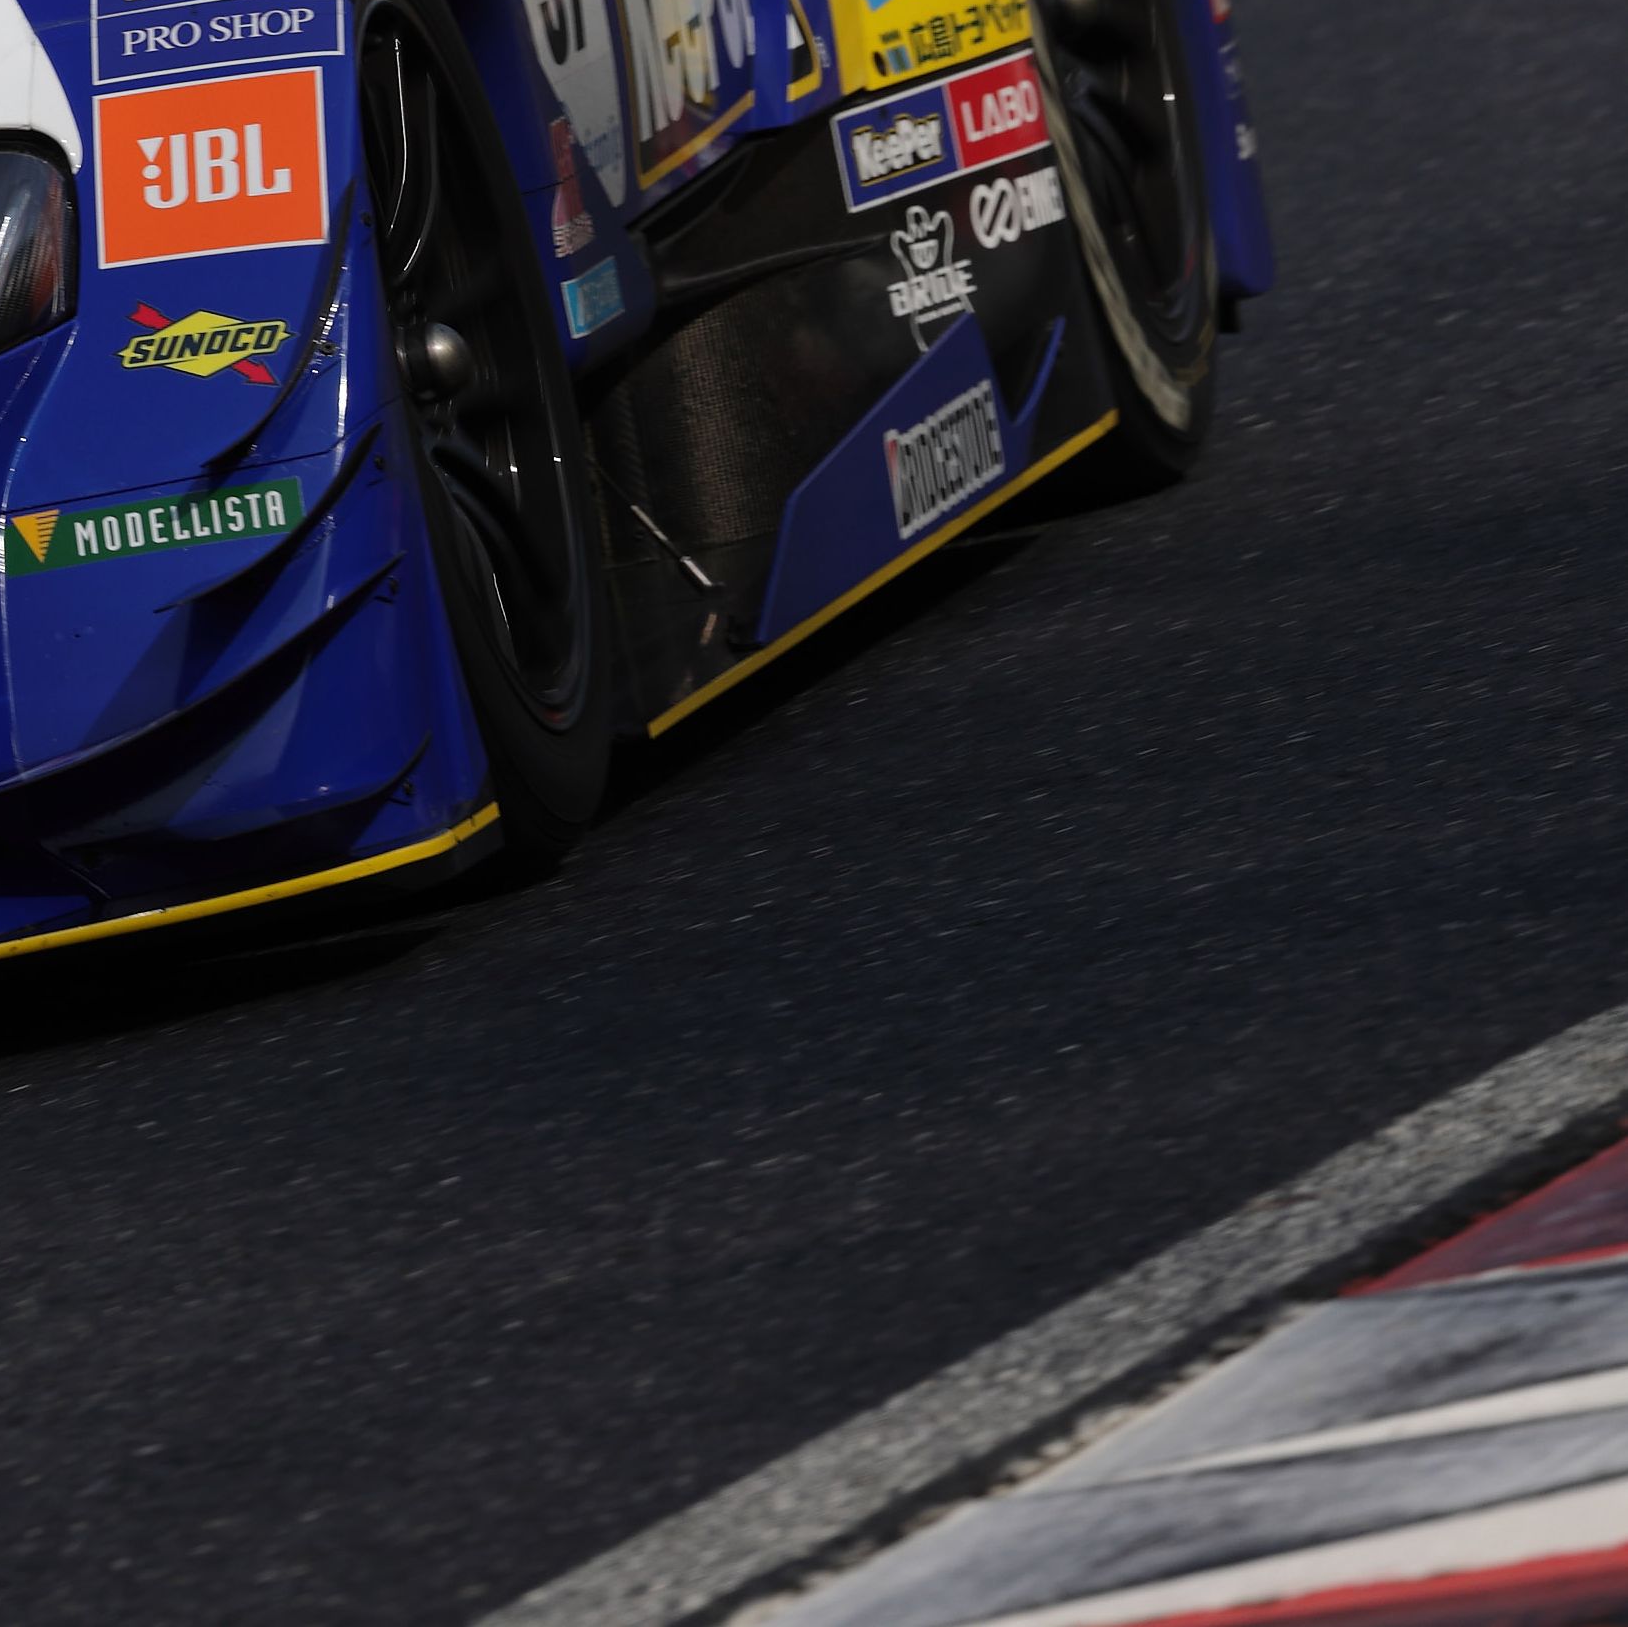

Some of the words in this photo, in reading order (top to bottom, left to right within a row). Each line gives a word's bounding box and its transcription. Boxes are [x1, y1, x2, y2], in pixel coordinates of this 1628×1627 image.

[121, 20, 203, 58] PRO
[207, 7, 315, 44] SHOP
[853, 110, 945, 182] KeePer
[959, 78, 1041, 144] LABO
[136, 122, 292, 210] JBL
[129, 318, 285, 370] SUNOCO
[73, 488, 289, 558] MODELLISTA
